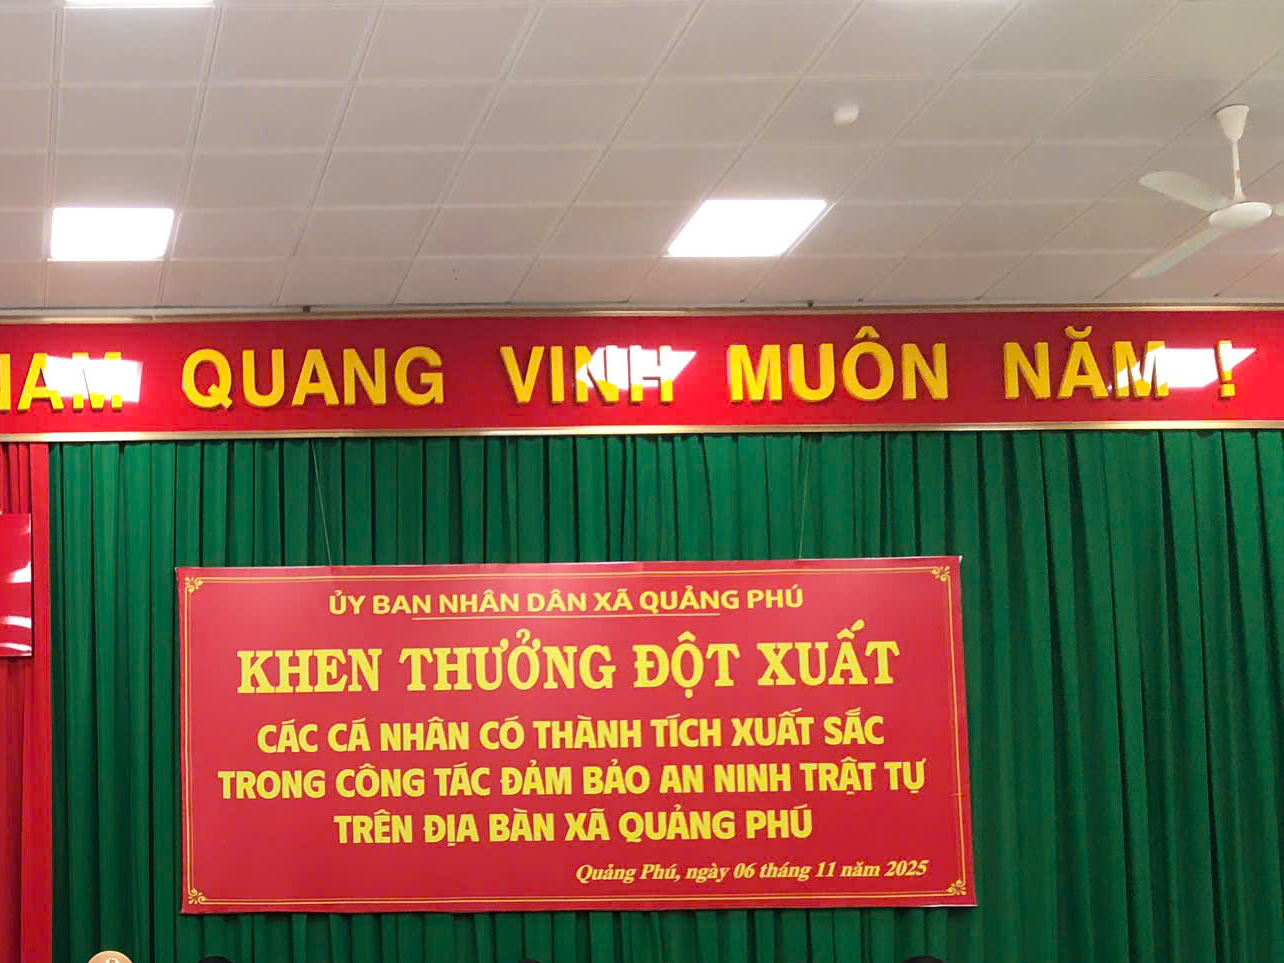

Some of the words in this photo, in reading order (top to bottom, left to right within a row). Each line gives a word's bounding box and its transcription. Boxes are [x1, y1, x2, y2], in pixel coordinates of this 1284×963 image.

[182, 347, 443, 408] QUANG
[500, 345, 674, 403] VINH
[728, 326, 948, 401] MUÔN
[1004, 326, 1170, 399] NĂM
[329, 590, 366, 615] ỦY
[373, 594, 431, 614] BAN
[439, 589, 520, 613] NHÂN
[526, 587, 587, 613] DÂN
[593, 588, 634, 612] XÃ
[639, 585, 739, 612] QUẢNG
[747, 584, 803, 608] PHÚ
[237, 648, 383, 694] KHEN
[399, 628, 616, 691] THƯỞNG
[632, 631, 740, 698] ĐỘT
[756, 619, 900, 686] XUẤT
[258, 719, 318, 753] CÁC
[328, 718, 371, 752] CÁ
[380, 716, 469, 751] NHÂN
[479, 715, 525, 750] CÓ
[532, 715, 642, 749] THÀNH
[650, 713, 722, 747] TÍCH
[732, 708, 814, 746] XUẤT
[824, 707, 884, 745] SẮC
[218, 770, 325, 799] TRONG
[336, 763, 425, 798] CÔNG
[434, 762, 490, 796] TÁC
[500, 760, 572, 795] ĐẢM
[583, 759, 650, 794] BẢO
[660, 764, 704, 793] AN
[714, 763, 791, 792] NINH
[800, 756, 876, 794] TRẬT
[884, 758, 926, 793] TỰ
[334, 809, 412, 843] TRÊN
[423, 814, 479, 846] ĐỊA
[489, 808, 554, 842] BÀN
[564, 808, 610, 841] XÃ
[619, 804, 735, 842] QUẢNG
[746, 804, 812, 839] PHÚ
[576, 864, 635, 883] Quảng
[640, 864, 680, 881] Phú,
[686, 863, 729, 882] ngày
[734, 863, 756, 878] 06
[759, 862, 810, 881] tháng
[816, 862, 836, 877] 11
[841, 862, 880, 877] năm
[884, 860, 929, 876] 2025
